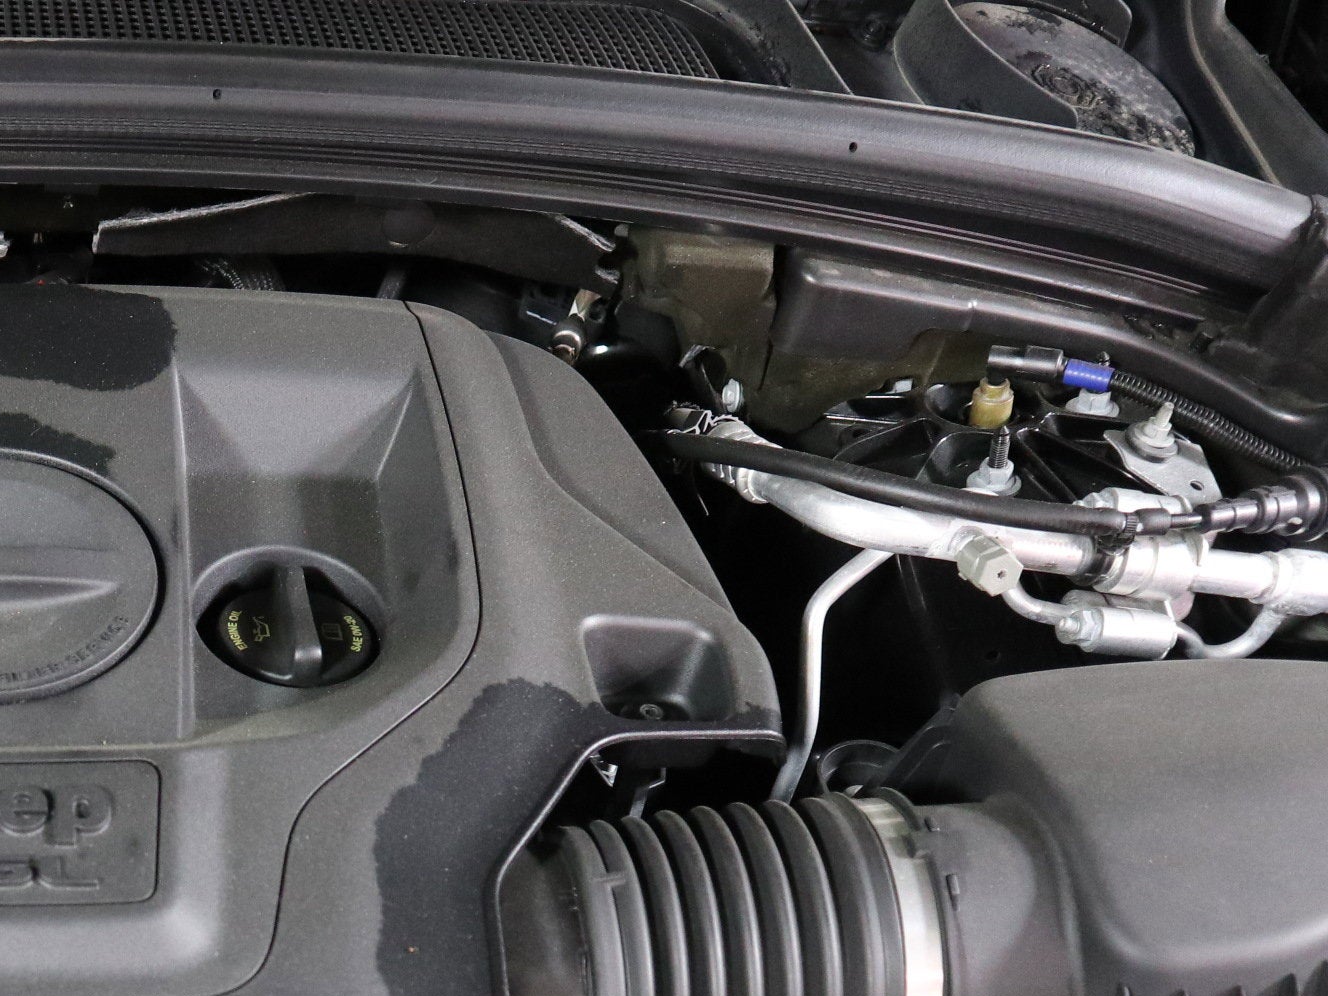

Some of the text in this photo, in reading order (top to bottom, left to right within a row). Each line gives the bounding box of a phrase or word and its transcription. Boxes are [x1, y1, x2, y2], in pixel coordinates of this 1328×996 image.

[64, 614, 129, 665] SERVICE
[228, 610, 248, 650] ENGINE OIL
[350, 636, 363, 652] SAE
